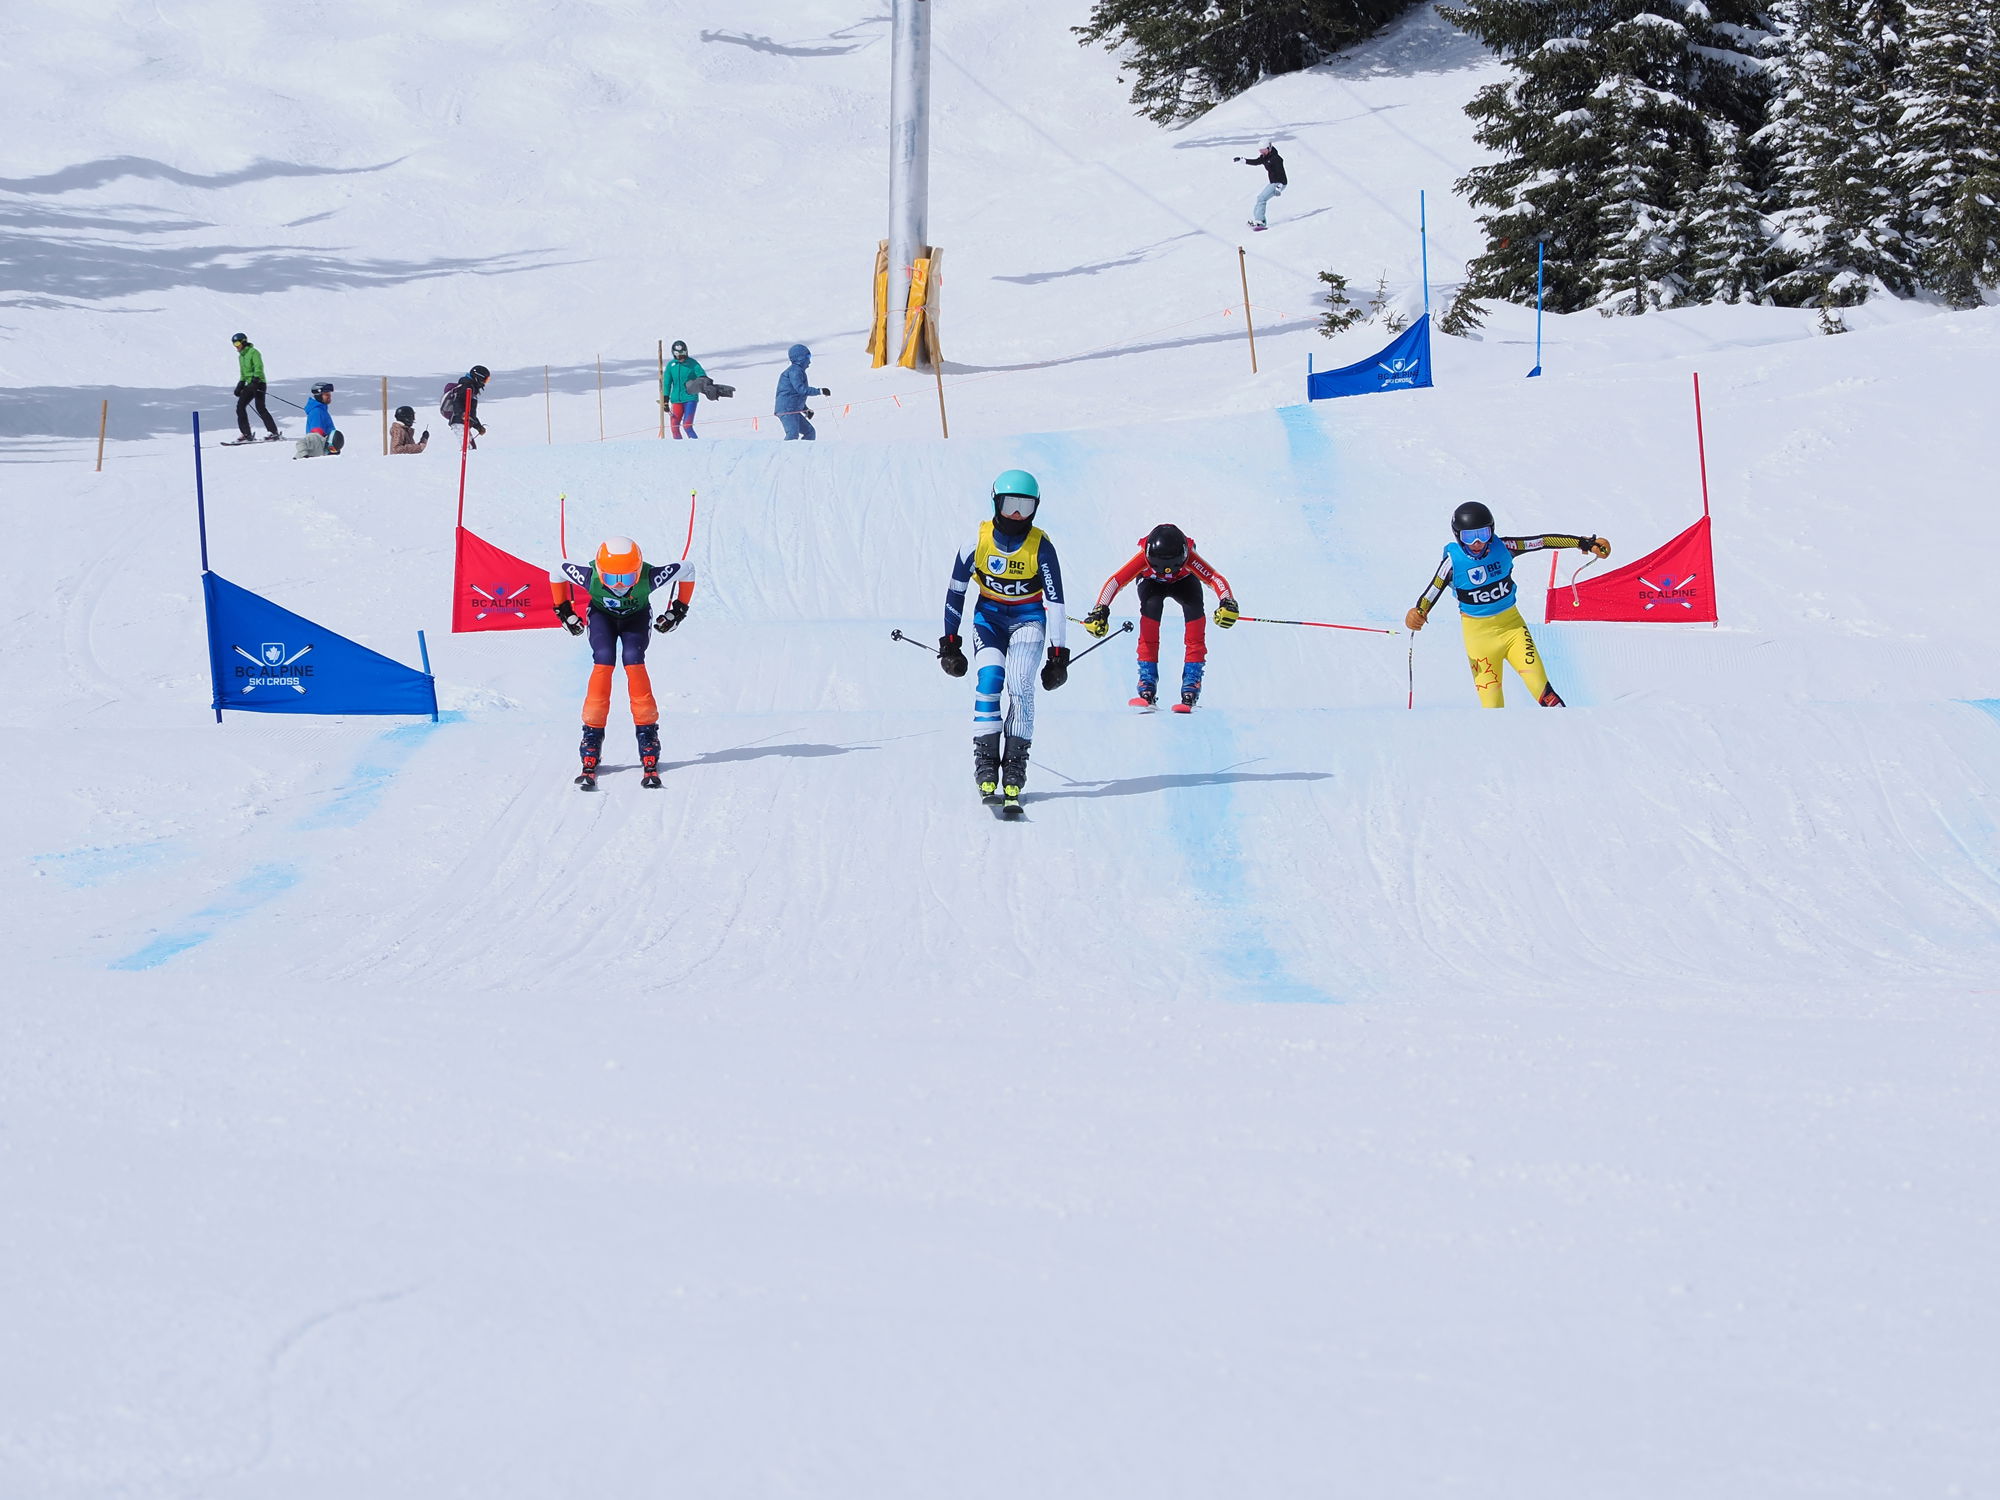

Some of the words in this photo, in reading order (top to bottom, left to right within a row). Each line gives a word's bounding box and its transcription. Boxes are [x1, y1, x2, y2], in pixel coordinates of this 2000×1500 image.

[1009, 560, 1025, 570] BC
[1191, 560, 1212, 577] HELLY
[1487, 561, 1502, 572] BC
[985, 575, 1029, 595] Teck
[1040, 562, 1058, 601] KARBON
[1468, 581, 1510, 604] Teck
[1638, 590, 1654, 599] BC
[1657, 588, 1697, 599] ALPINE
[471, 599, 488, 608] BC
[490, 598, 531, 608] ALPINE
[235, 666, 256, 678] BC
[260, 665, 315, 678] ALPINE
[249, 677, 265, 686] SKI
[266, 677, 300, 686] CROSS
